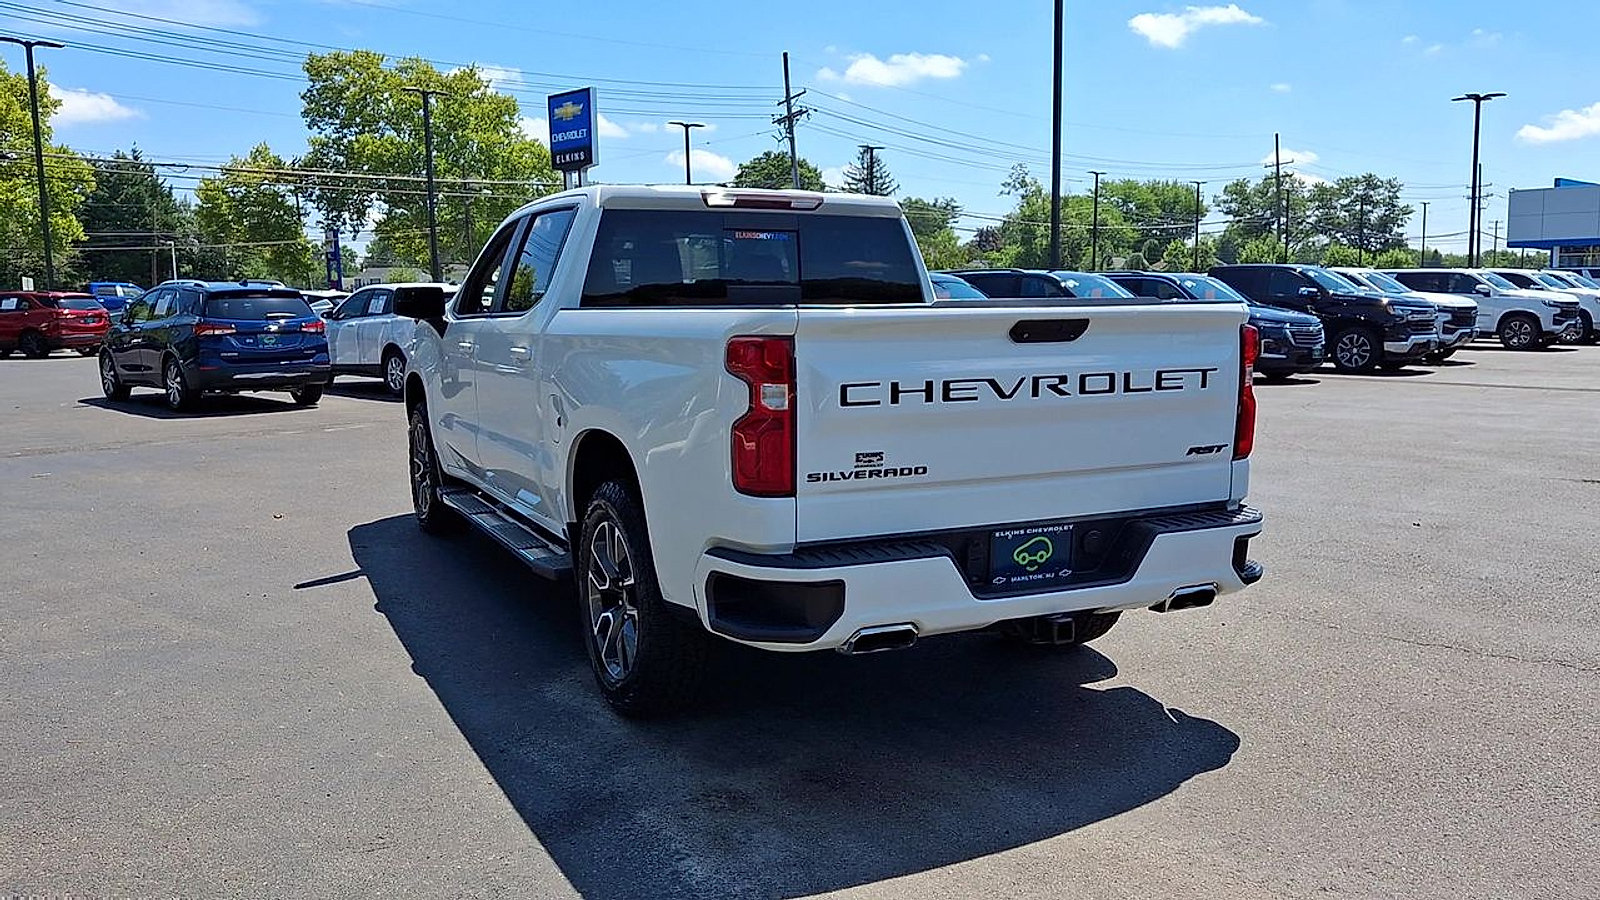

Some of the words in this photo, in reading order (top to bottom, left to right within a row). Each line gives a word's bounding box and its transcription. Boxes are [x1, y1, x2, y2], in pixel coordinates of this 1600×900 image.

[552, 128, 588, 143] CHEVROLET
[556, 151, 585, 164] ELKINS
[839, 367, 1218, 407] CHEVROLET
[1186, 443, 1229, 456] RST
[807, 466, 927, 483] SILVERADO
[995, 528, 1025, 538] ELKINS
[1026, 524, 1074, 534] CHEVROLET
